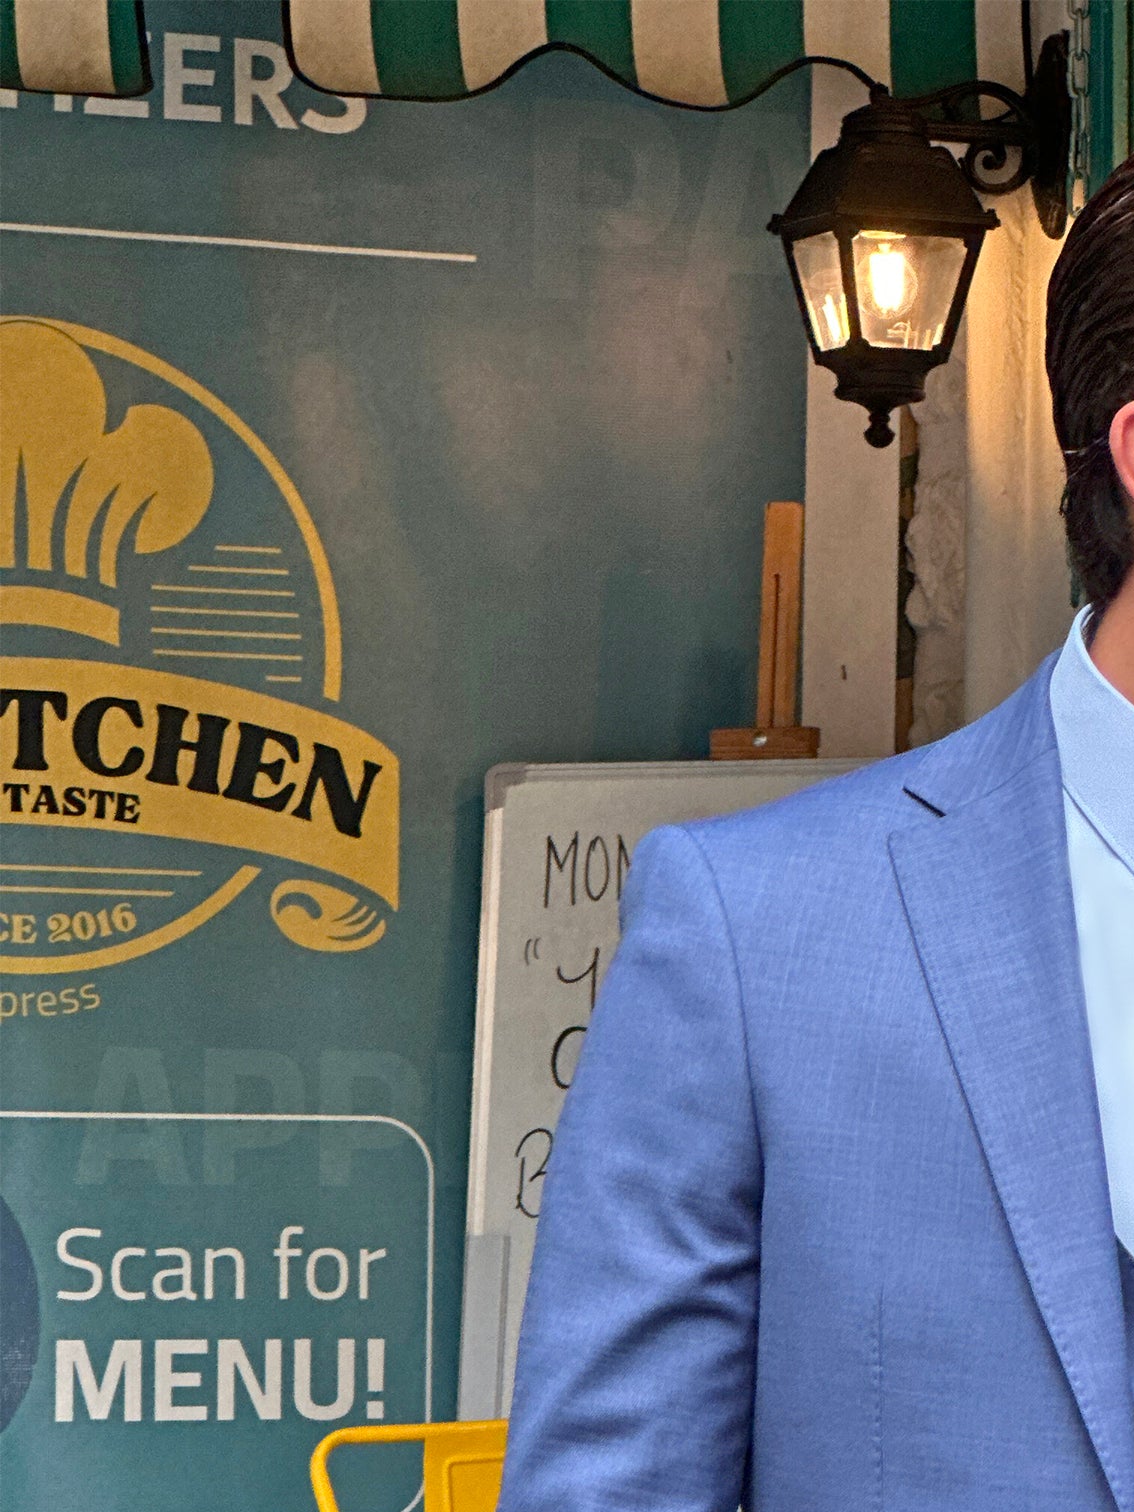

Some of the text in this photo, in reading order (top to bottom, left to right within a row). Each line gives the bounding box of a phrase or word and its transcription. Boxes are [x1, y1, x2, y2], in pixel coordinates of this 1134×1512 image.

[3, 783, 141, 824] TASTE
[47, 902, 137, 943] 2016
[56, 1225, 387, 1301] Scan for
[54, 1338, 386, 1423] MENU!
